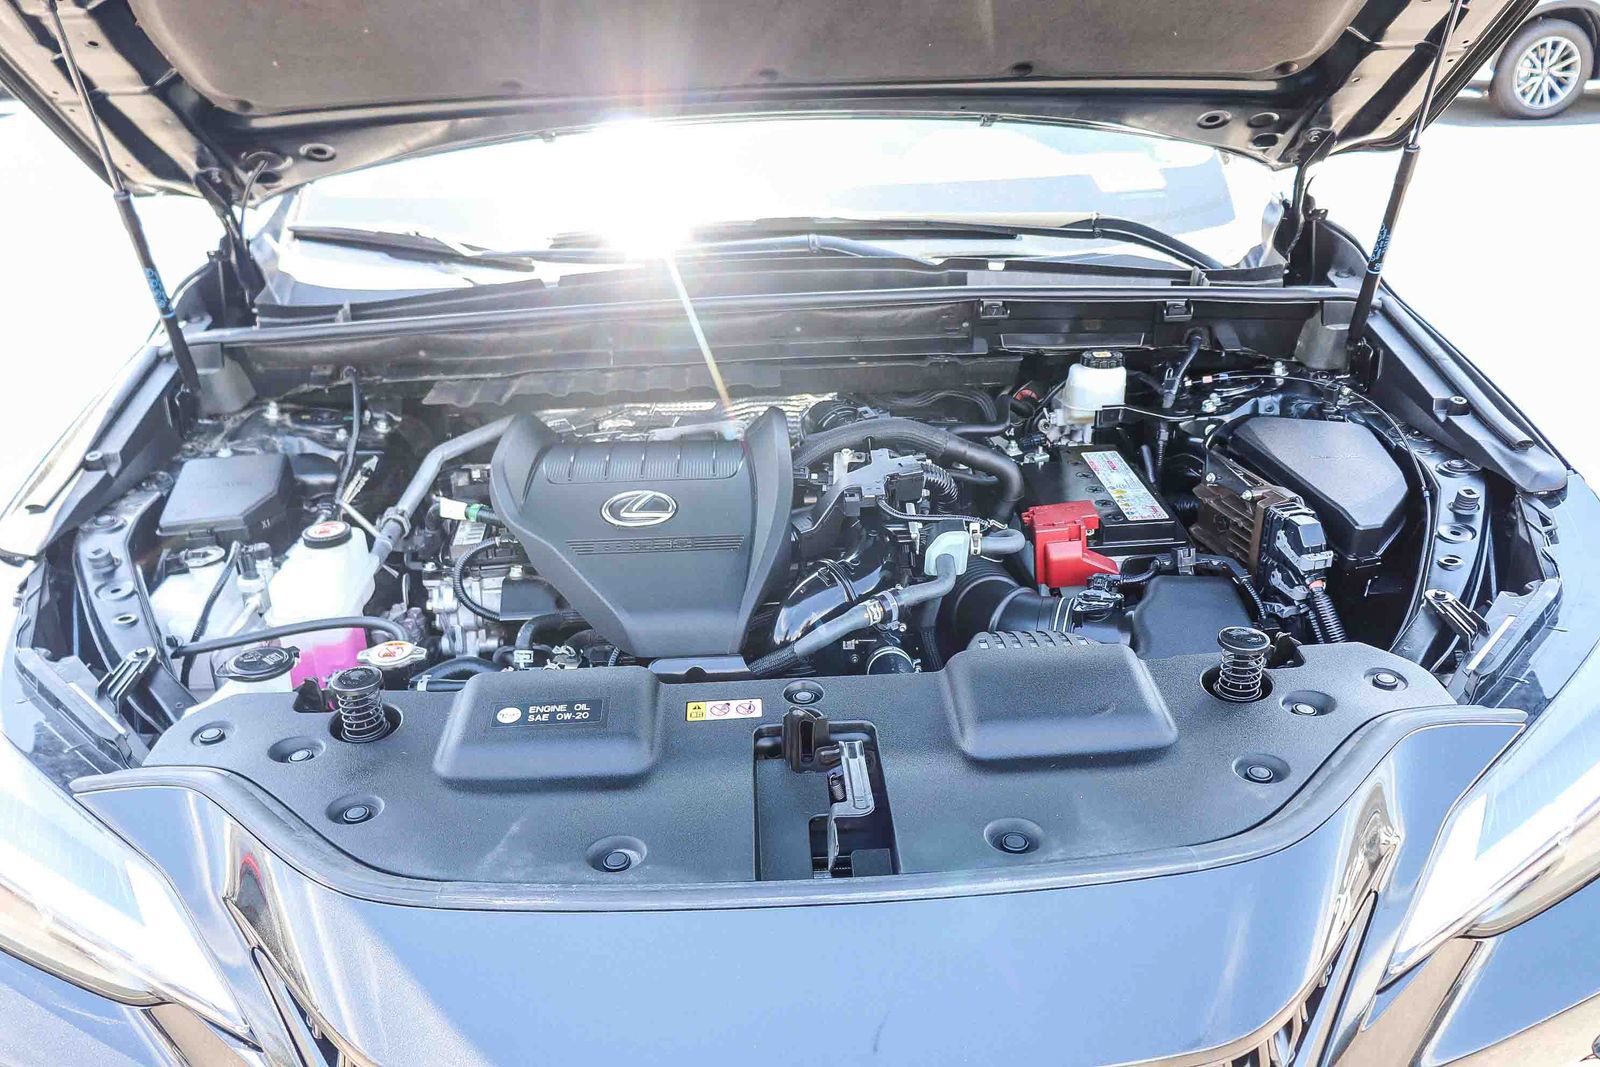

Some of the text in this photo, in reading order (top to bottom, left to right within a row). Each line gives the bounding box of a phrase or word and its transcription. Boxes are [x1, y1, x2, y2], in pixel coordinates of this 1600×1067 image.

[528, 703, 591, 714] ENGINE OIL
[527, 713, 550, 722] SAE
